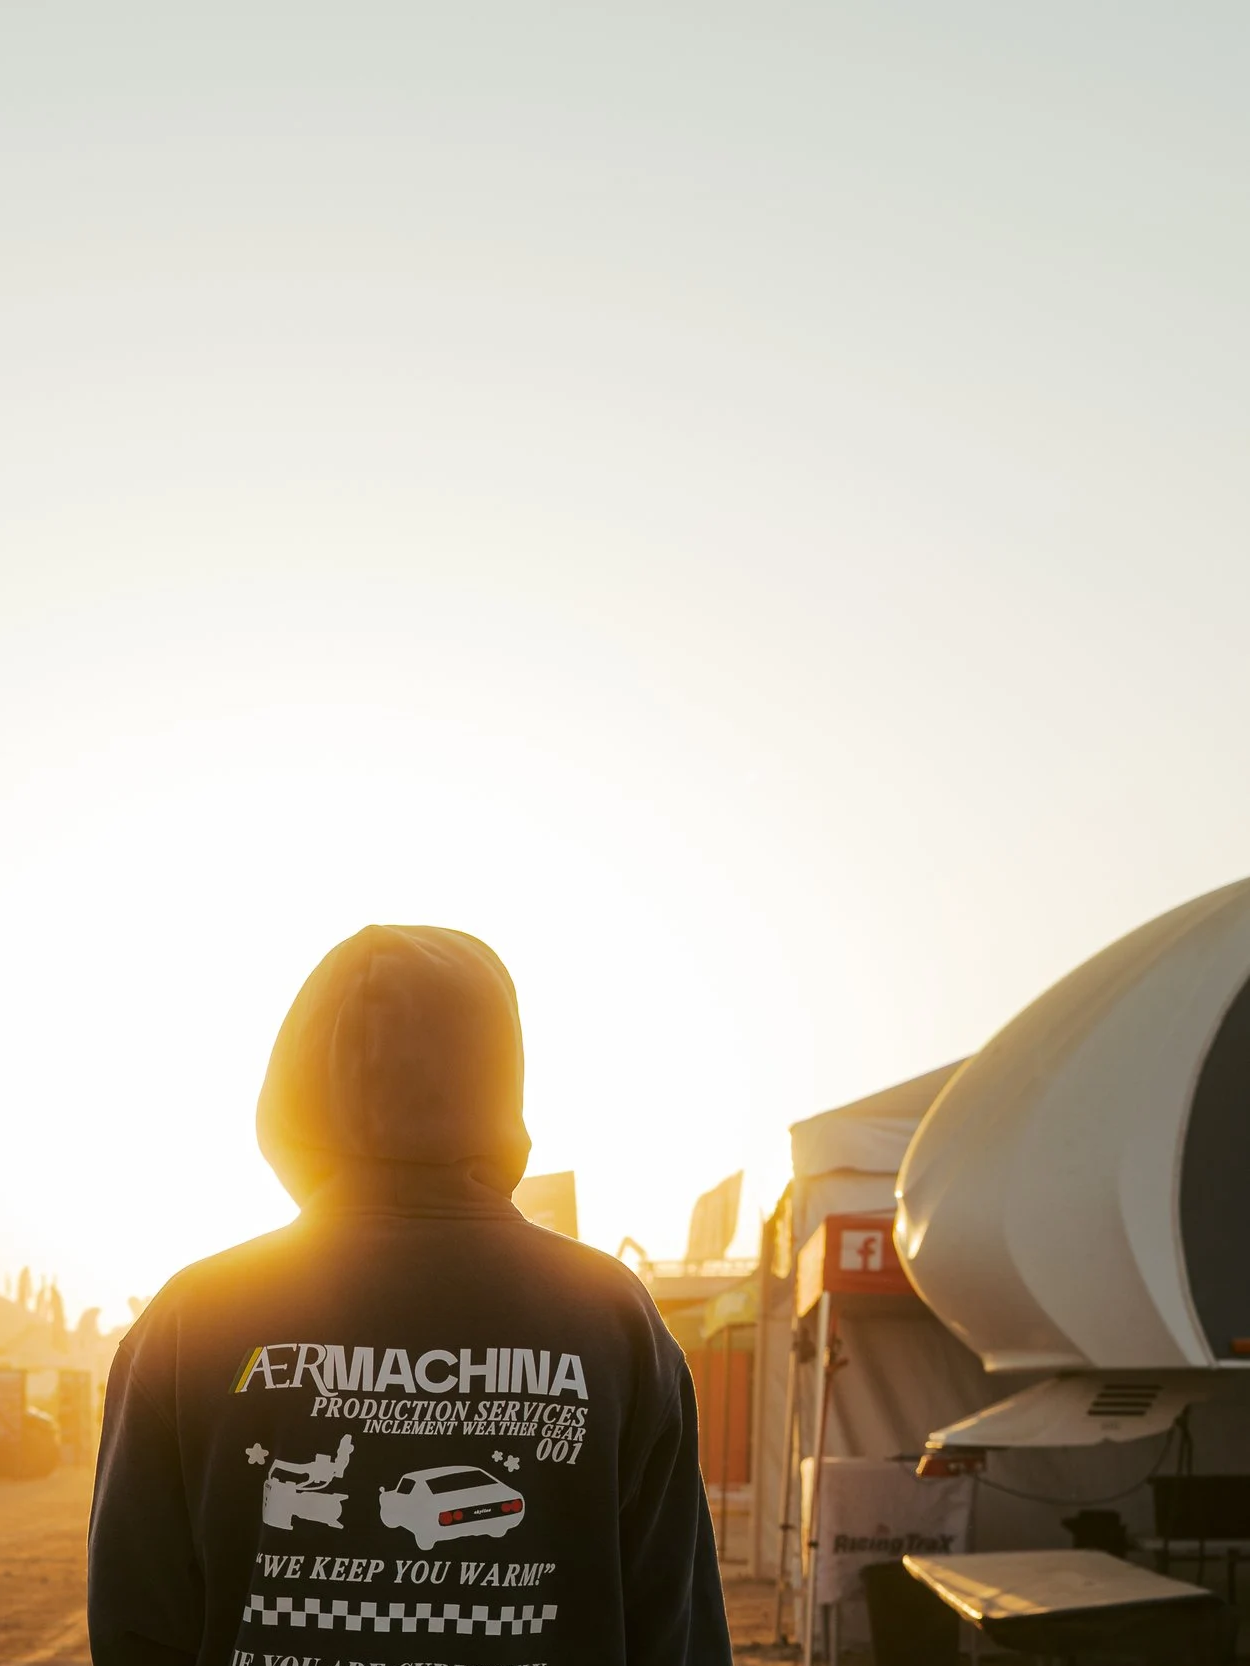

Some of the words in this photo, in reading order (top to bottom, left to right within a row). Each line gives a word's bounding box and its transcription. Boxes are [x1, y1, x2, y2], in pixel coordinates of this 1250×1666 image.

[311, 1397, 471, 1422] PRODUCTION
[474, 1401, 588, 1428] SERVICES
[363, 1419, 457, 1436] INCLEMENT
[462, 1421, 536, 1437] WEATHER
[541, 1424, 586, 1442] GEAR
[536, 1438, 583, 1465] 001
[309, 1556, 385, 1583] KEEP
[393, 1560, 450, 1584] YOU
